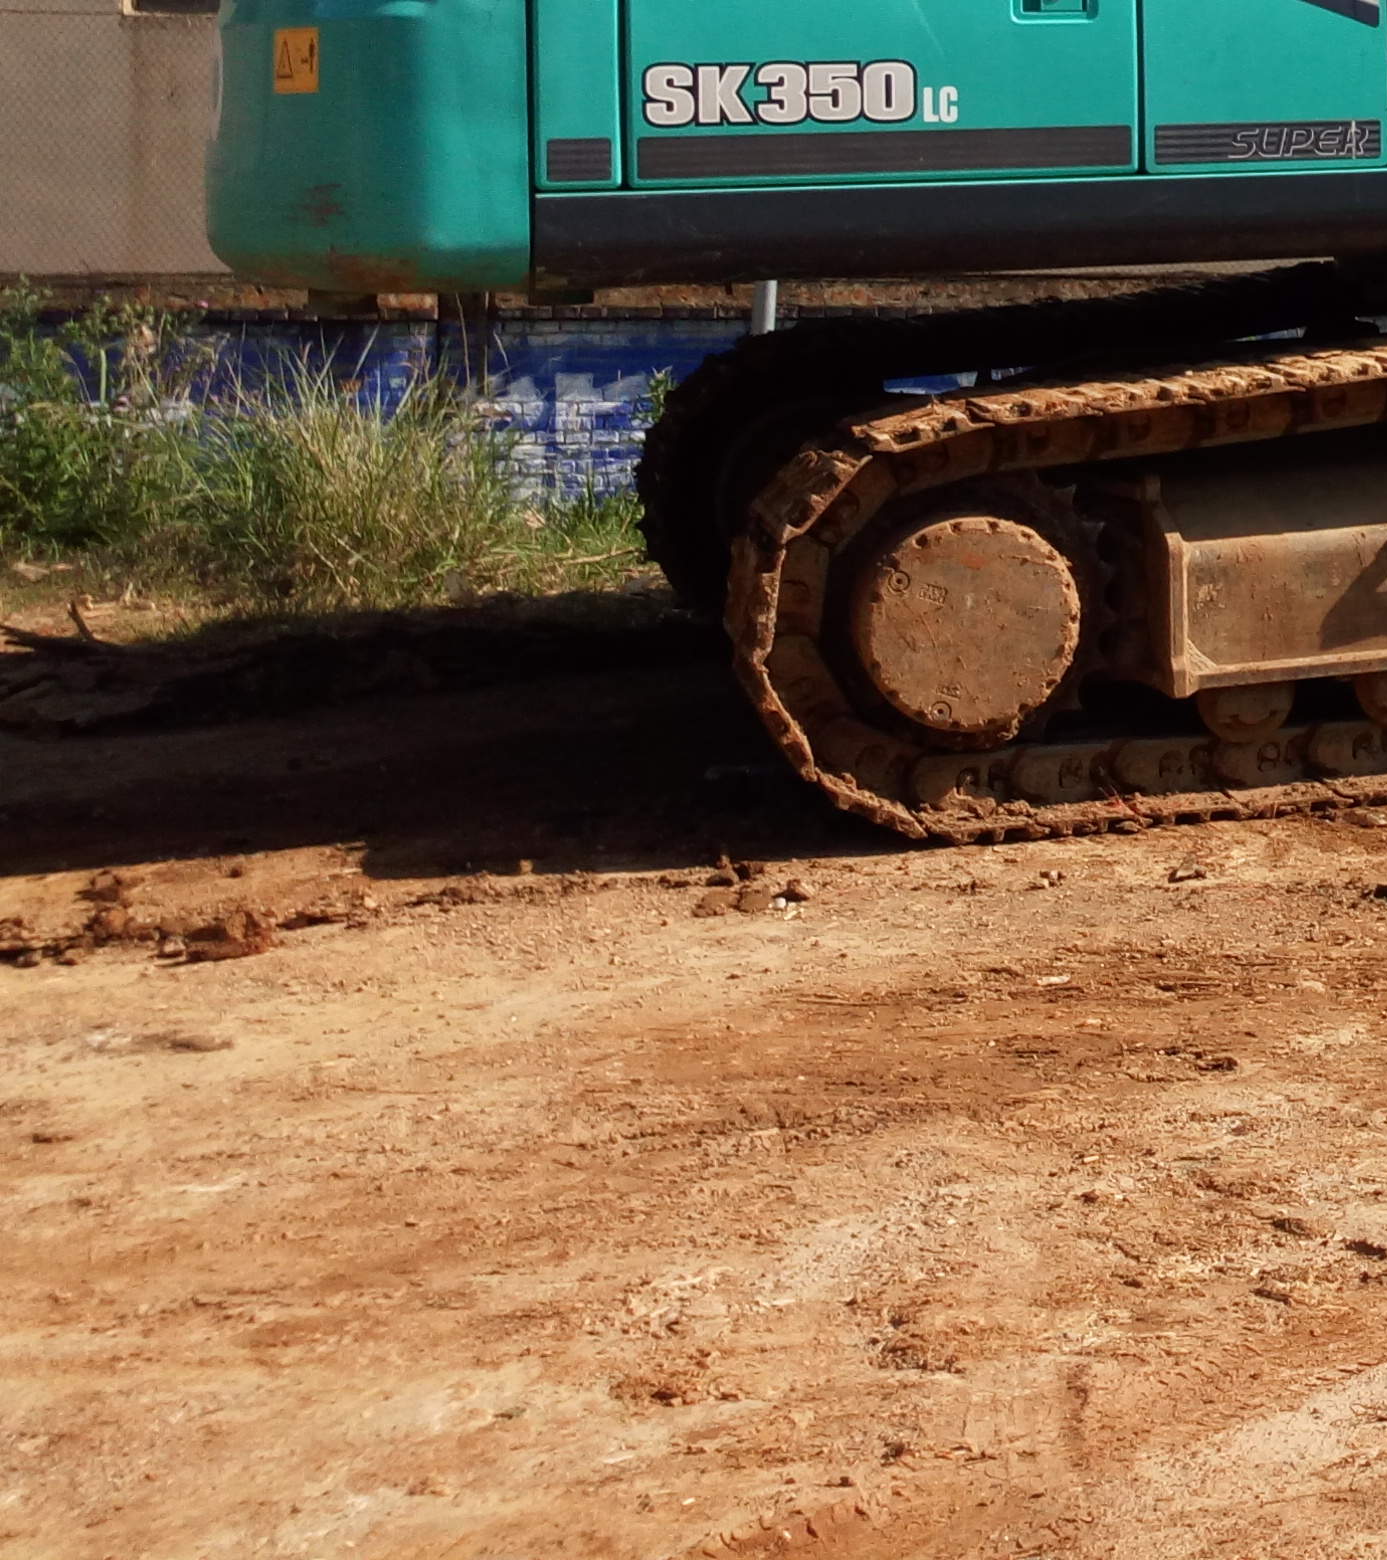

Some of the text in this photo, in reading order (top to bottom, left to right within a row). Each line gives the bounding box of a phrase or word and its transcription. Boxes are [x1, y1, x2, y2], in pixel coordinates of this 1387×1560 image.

[643, 60, 958, 128] SK350 LC
[1228, 126, 1369, 158] SUPER
